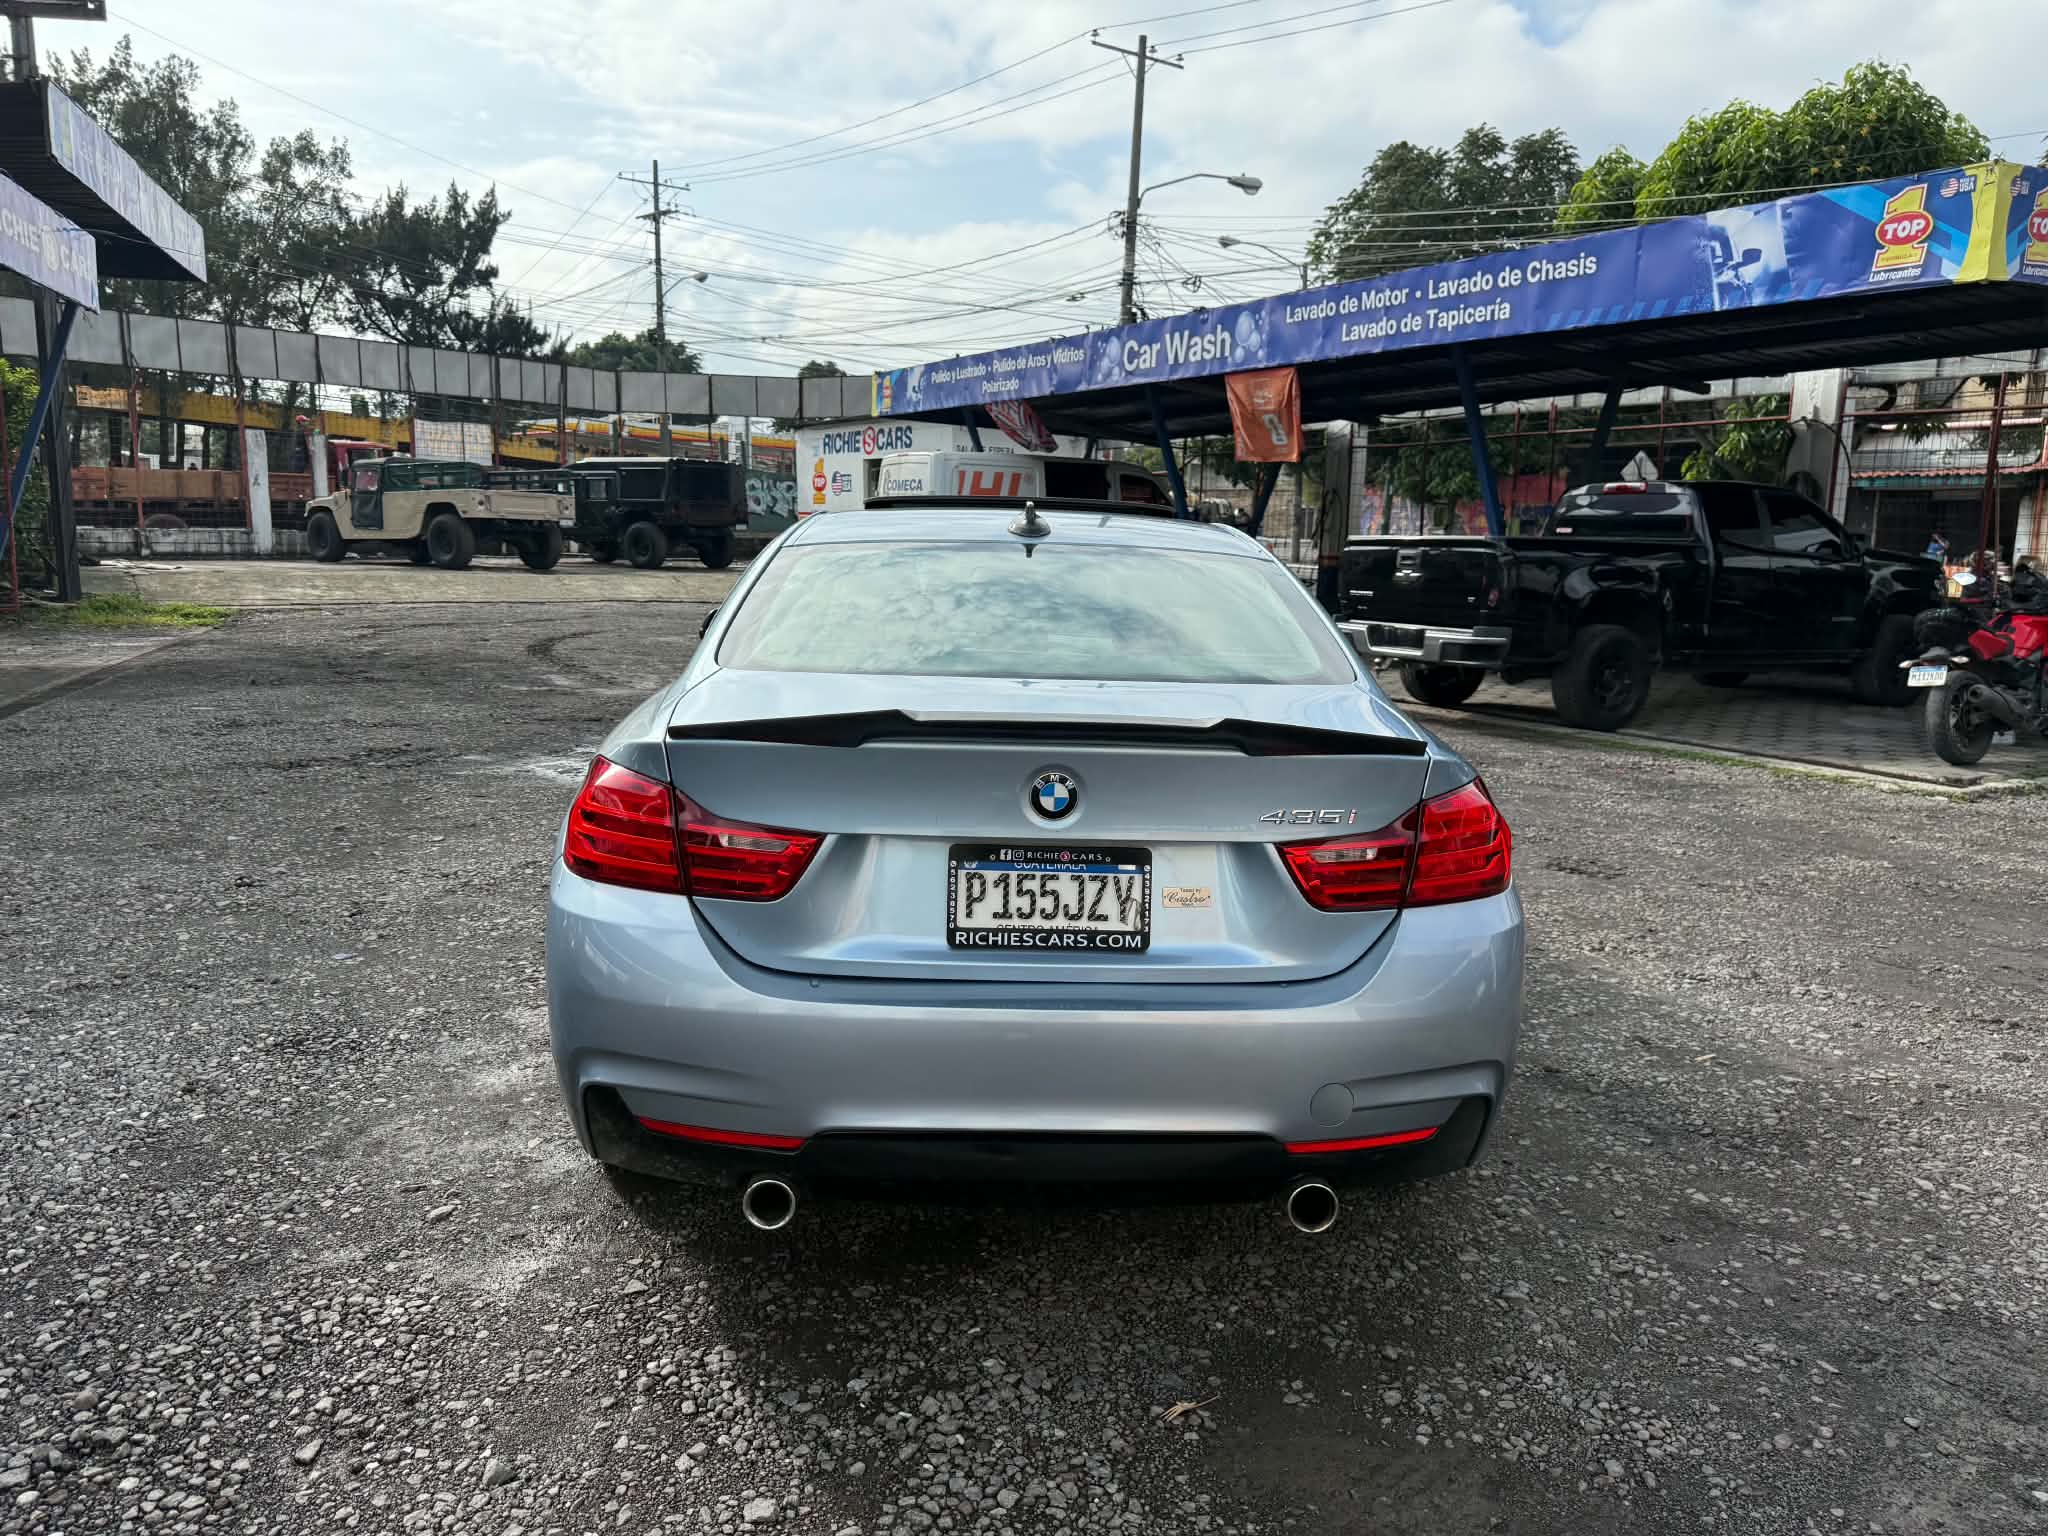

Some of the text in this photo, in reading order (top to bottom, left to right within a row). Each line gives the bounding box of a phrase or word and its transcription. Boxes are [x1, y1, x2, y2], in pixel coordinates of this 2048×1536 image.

[1884, 218, 1927, 240] TOP
[2032, 216, 2048, 235] TO
[1869, 267, 1921, 282] Lubricantes
[1286, 252, 1598, 324] Lavado de Motor Lavado de Chasis
[1341, 298, 1511, 342] Lavado de Tapicería
[1122, 325, 1232, 373] Car Wash
[931, 369, 951, 384] Pulido
[956, 363, 986, 380] Lustrado
[992, 357, 1016, 373] Pulido
[1016, 357, 1026, 369] de
[1027, 354, 1045, 369] Aros
[1052, 346, 1085, 364] Vidrios
[982, 377, 1019, 394] Polarizado
[876, 425, 913, 451] CARS
[886, 479, 923, 492] COMECA
[1259, 808, 1357, 825] 435i
[955, 931, 1142, 949] RICHIESCARS.COM
